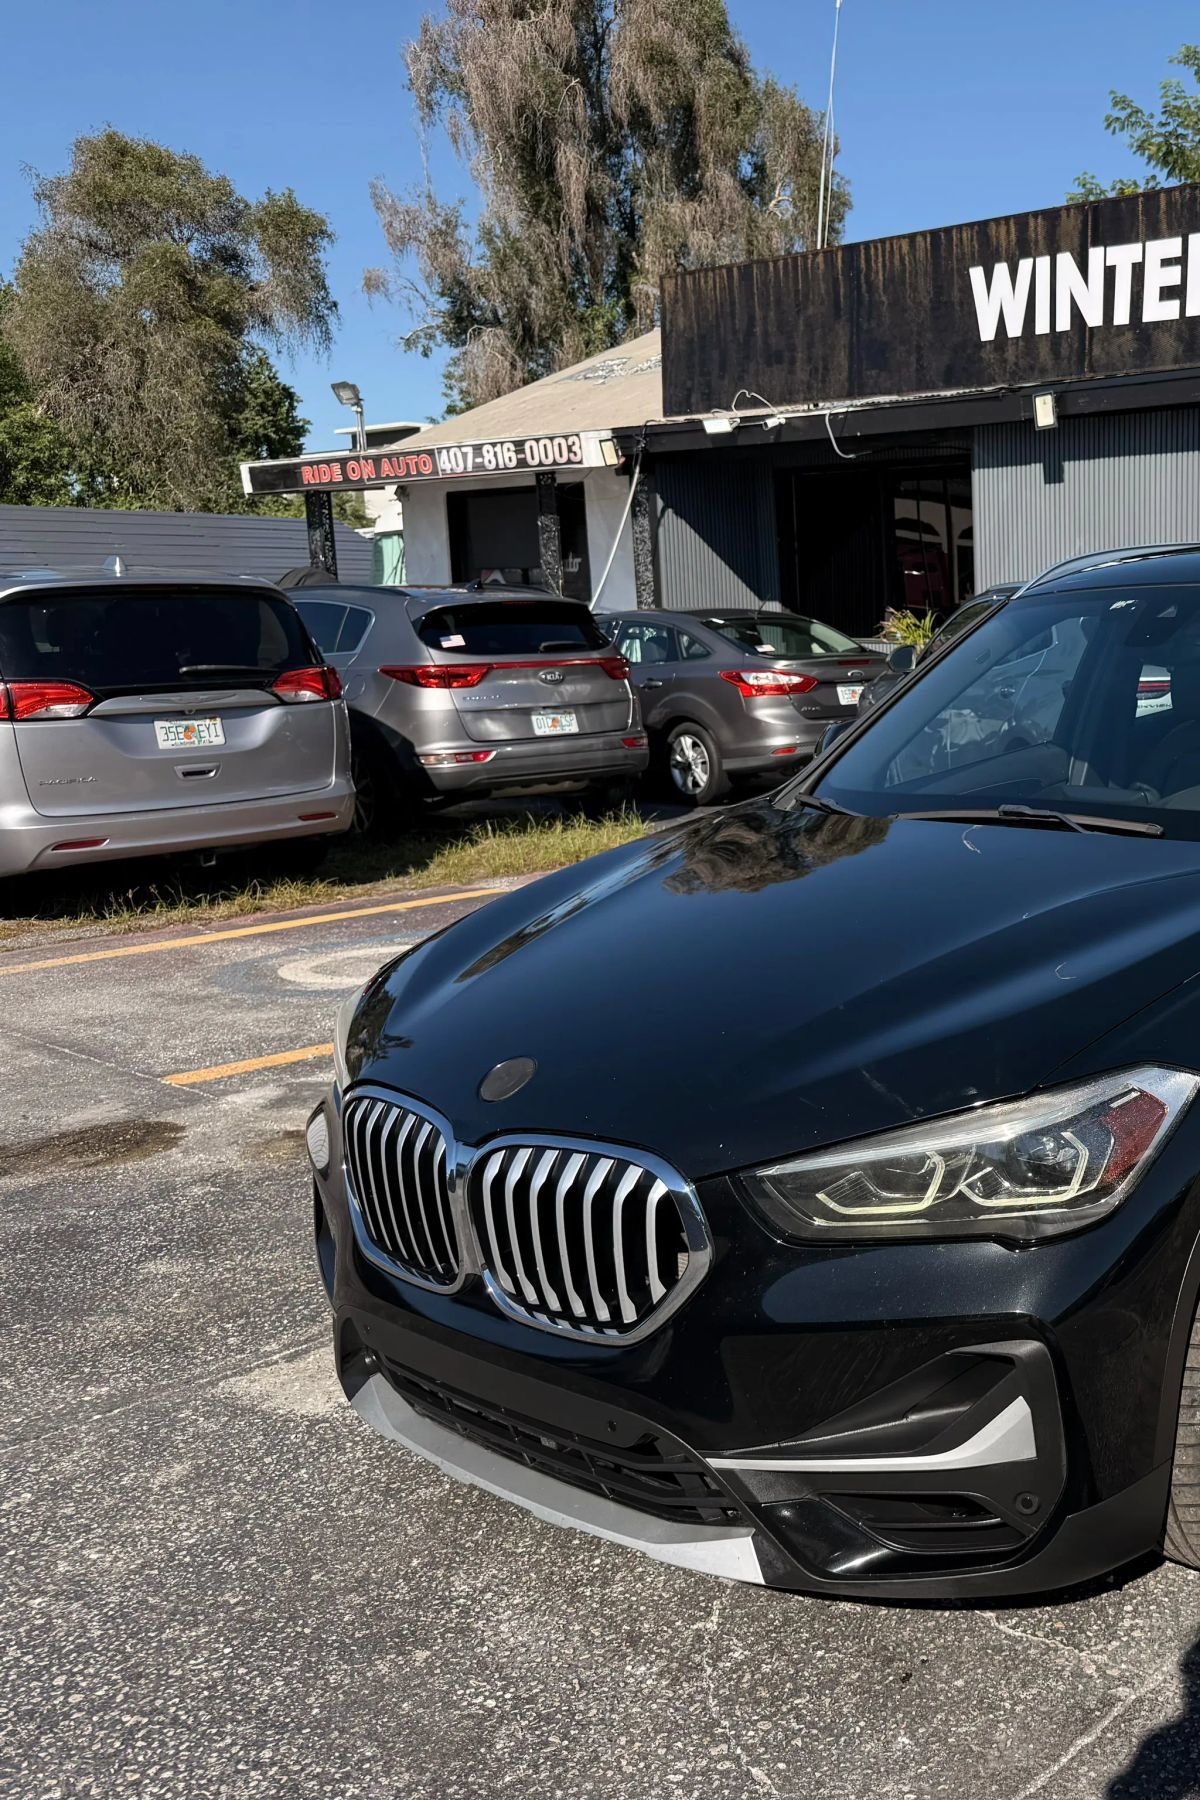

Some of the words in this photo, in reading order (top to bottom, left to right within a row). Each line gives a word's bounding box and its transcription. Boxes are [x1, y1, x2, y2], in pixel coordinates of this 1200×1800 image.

[301, 462, 343, 484] RIDE
[347, 459, 375, 481] ON
[381, 454, 432, 478] AUTO
[439, 435, 582, 474] 407-816-0003
